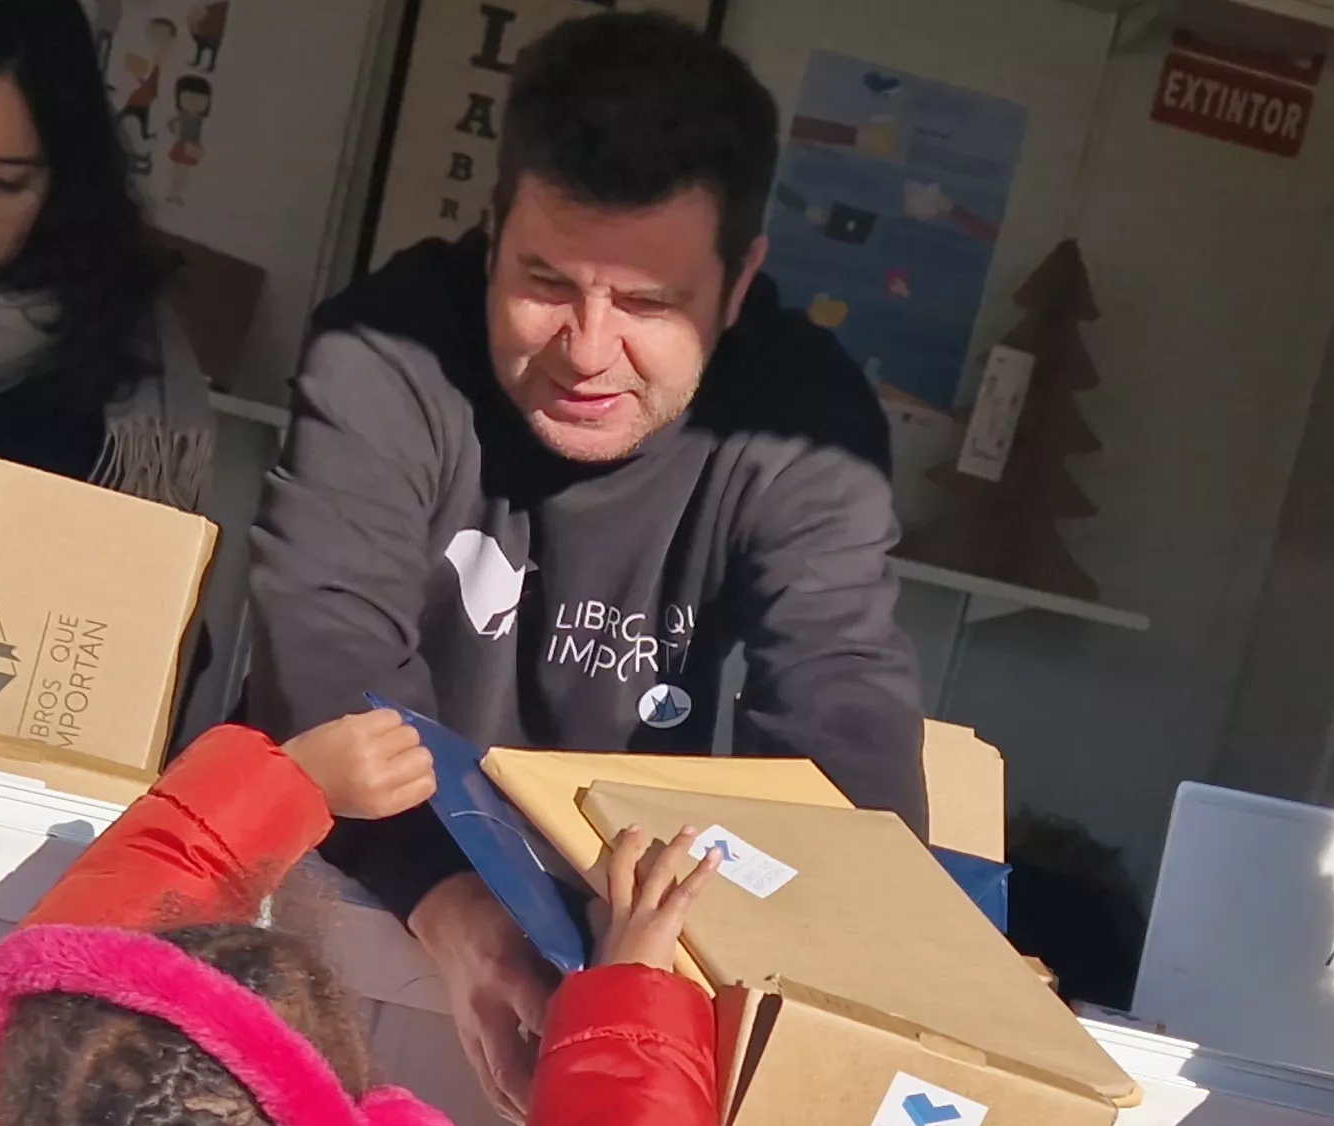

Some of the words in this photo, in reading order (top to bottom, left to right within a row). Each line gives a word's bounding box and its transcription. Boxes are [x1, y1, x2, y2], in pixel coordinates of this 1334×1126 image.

[1163, 68, 1303, 140] EXTINTOR
[29, 678, 62, 744] IBROS
[50, 614, 79, 663] QUE
[56, 619, 108, 747] MPORTAN
